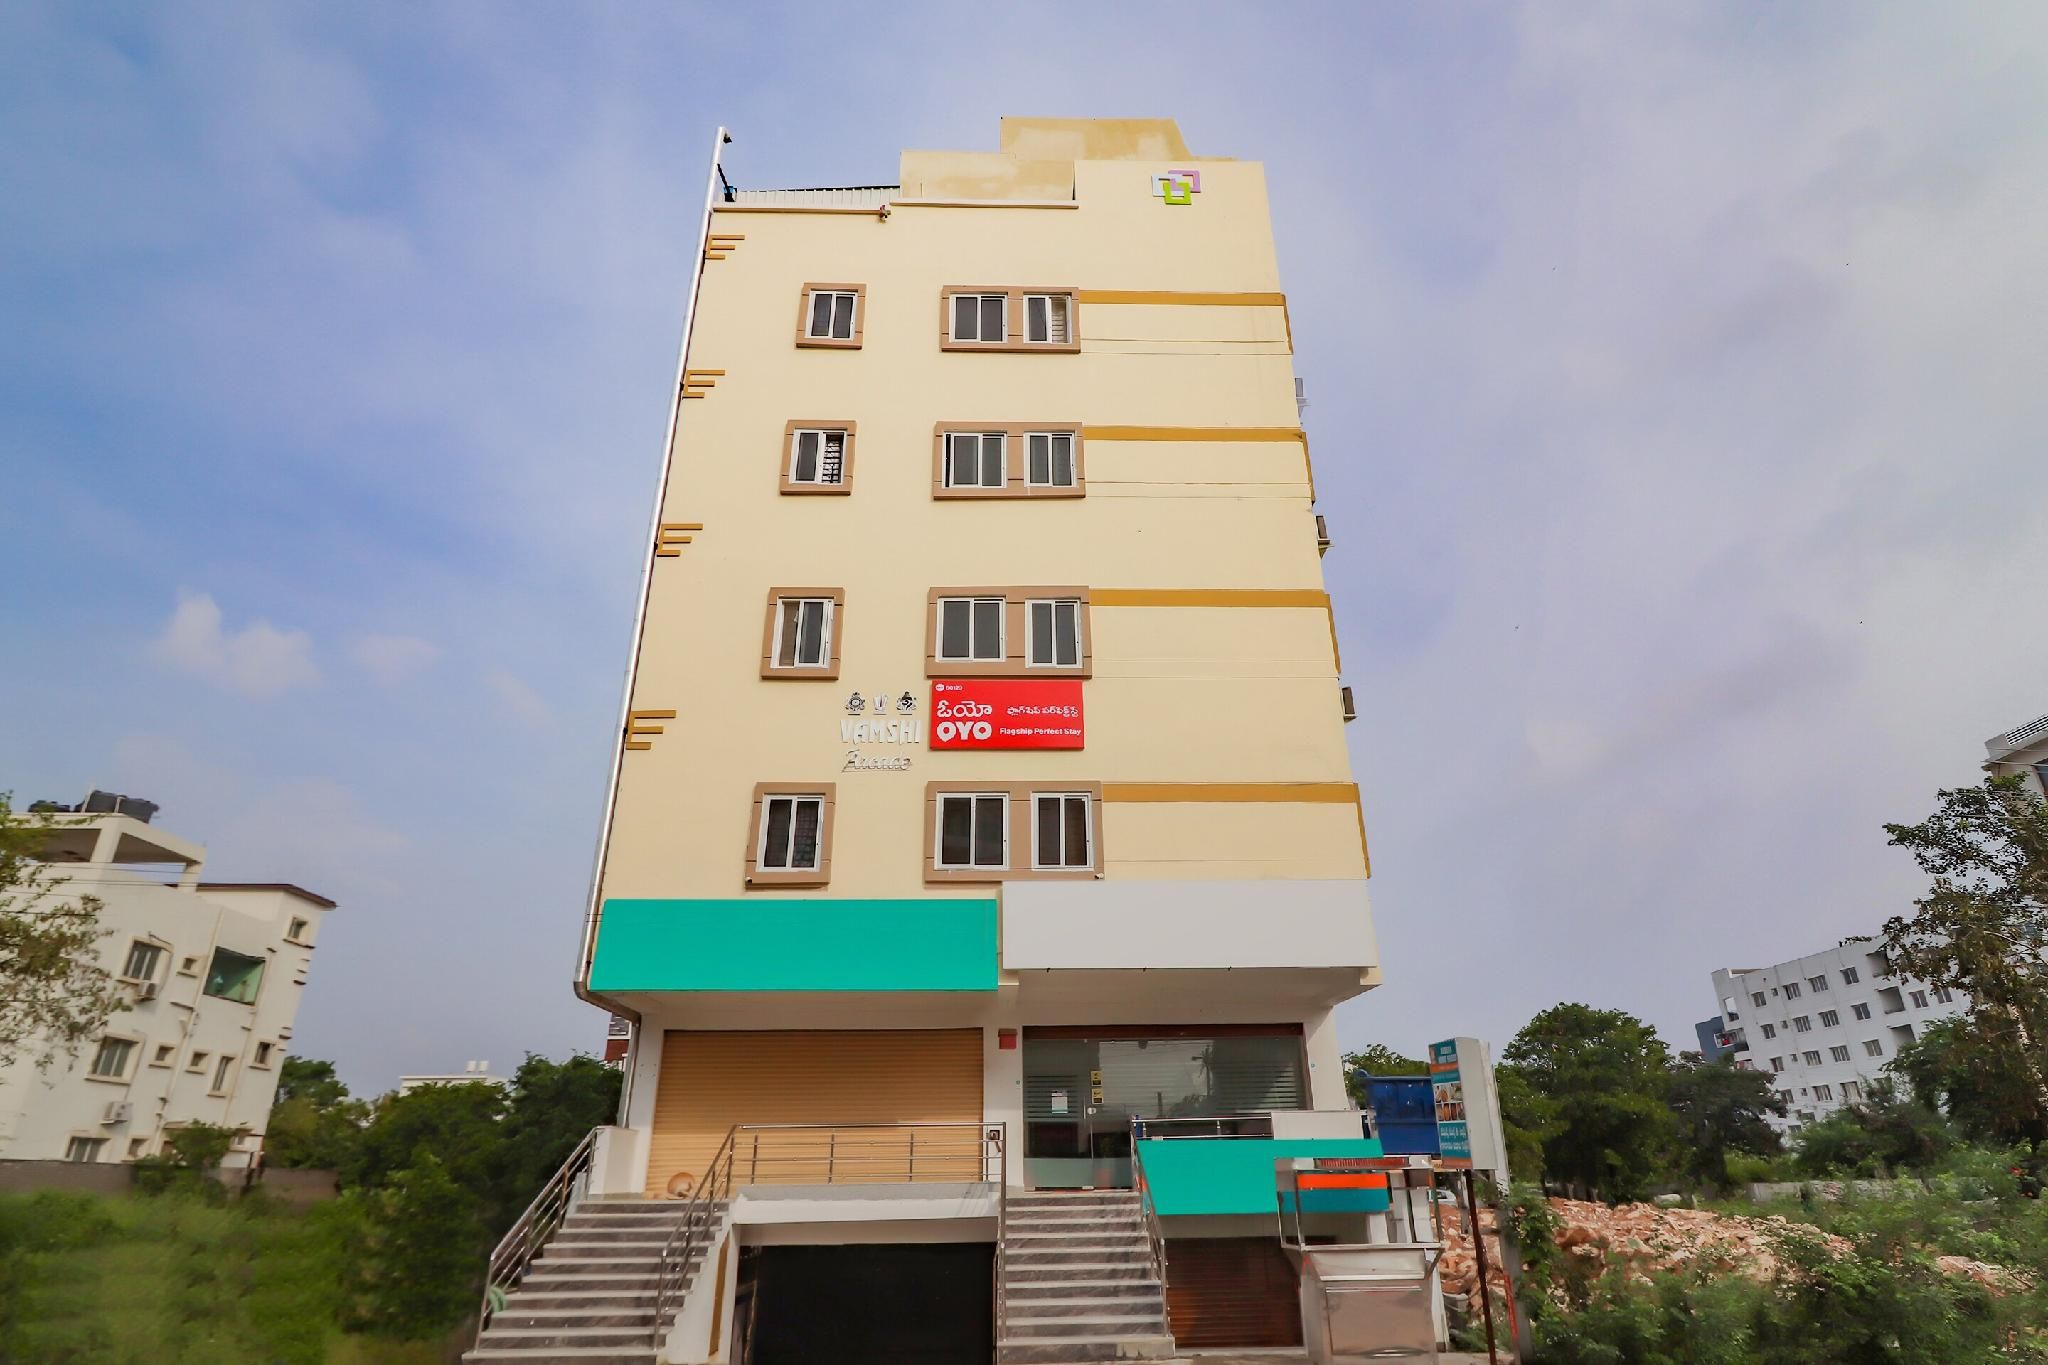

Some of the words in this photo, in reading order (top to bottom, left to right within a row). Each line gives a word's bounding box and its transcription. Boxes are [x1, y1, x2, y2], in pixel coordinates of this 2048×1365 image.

[937, 700, 992, 718] ఓయో
[937, 721, 992, 743] OYO
[999, 727, 1033, 736] Flagship
[1034, 727, 1063, 735] Perfect
[1064, 727, 1082, 736] Stay
